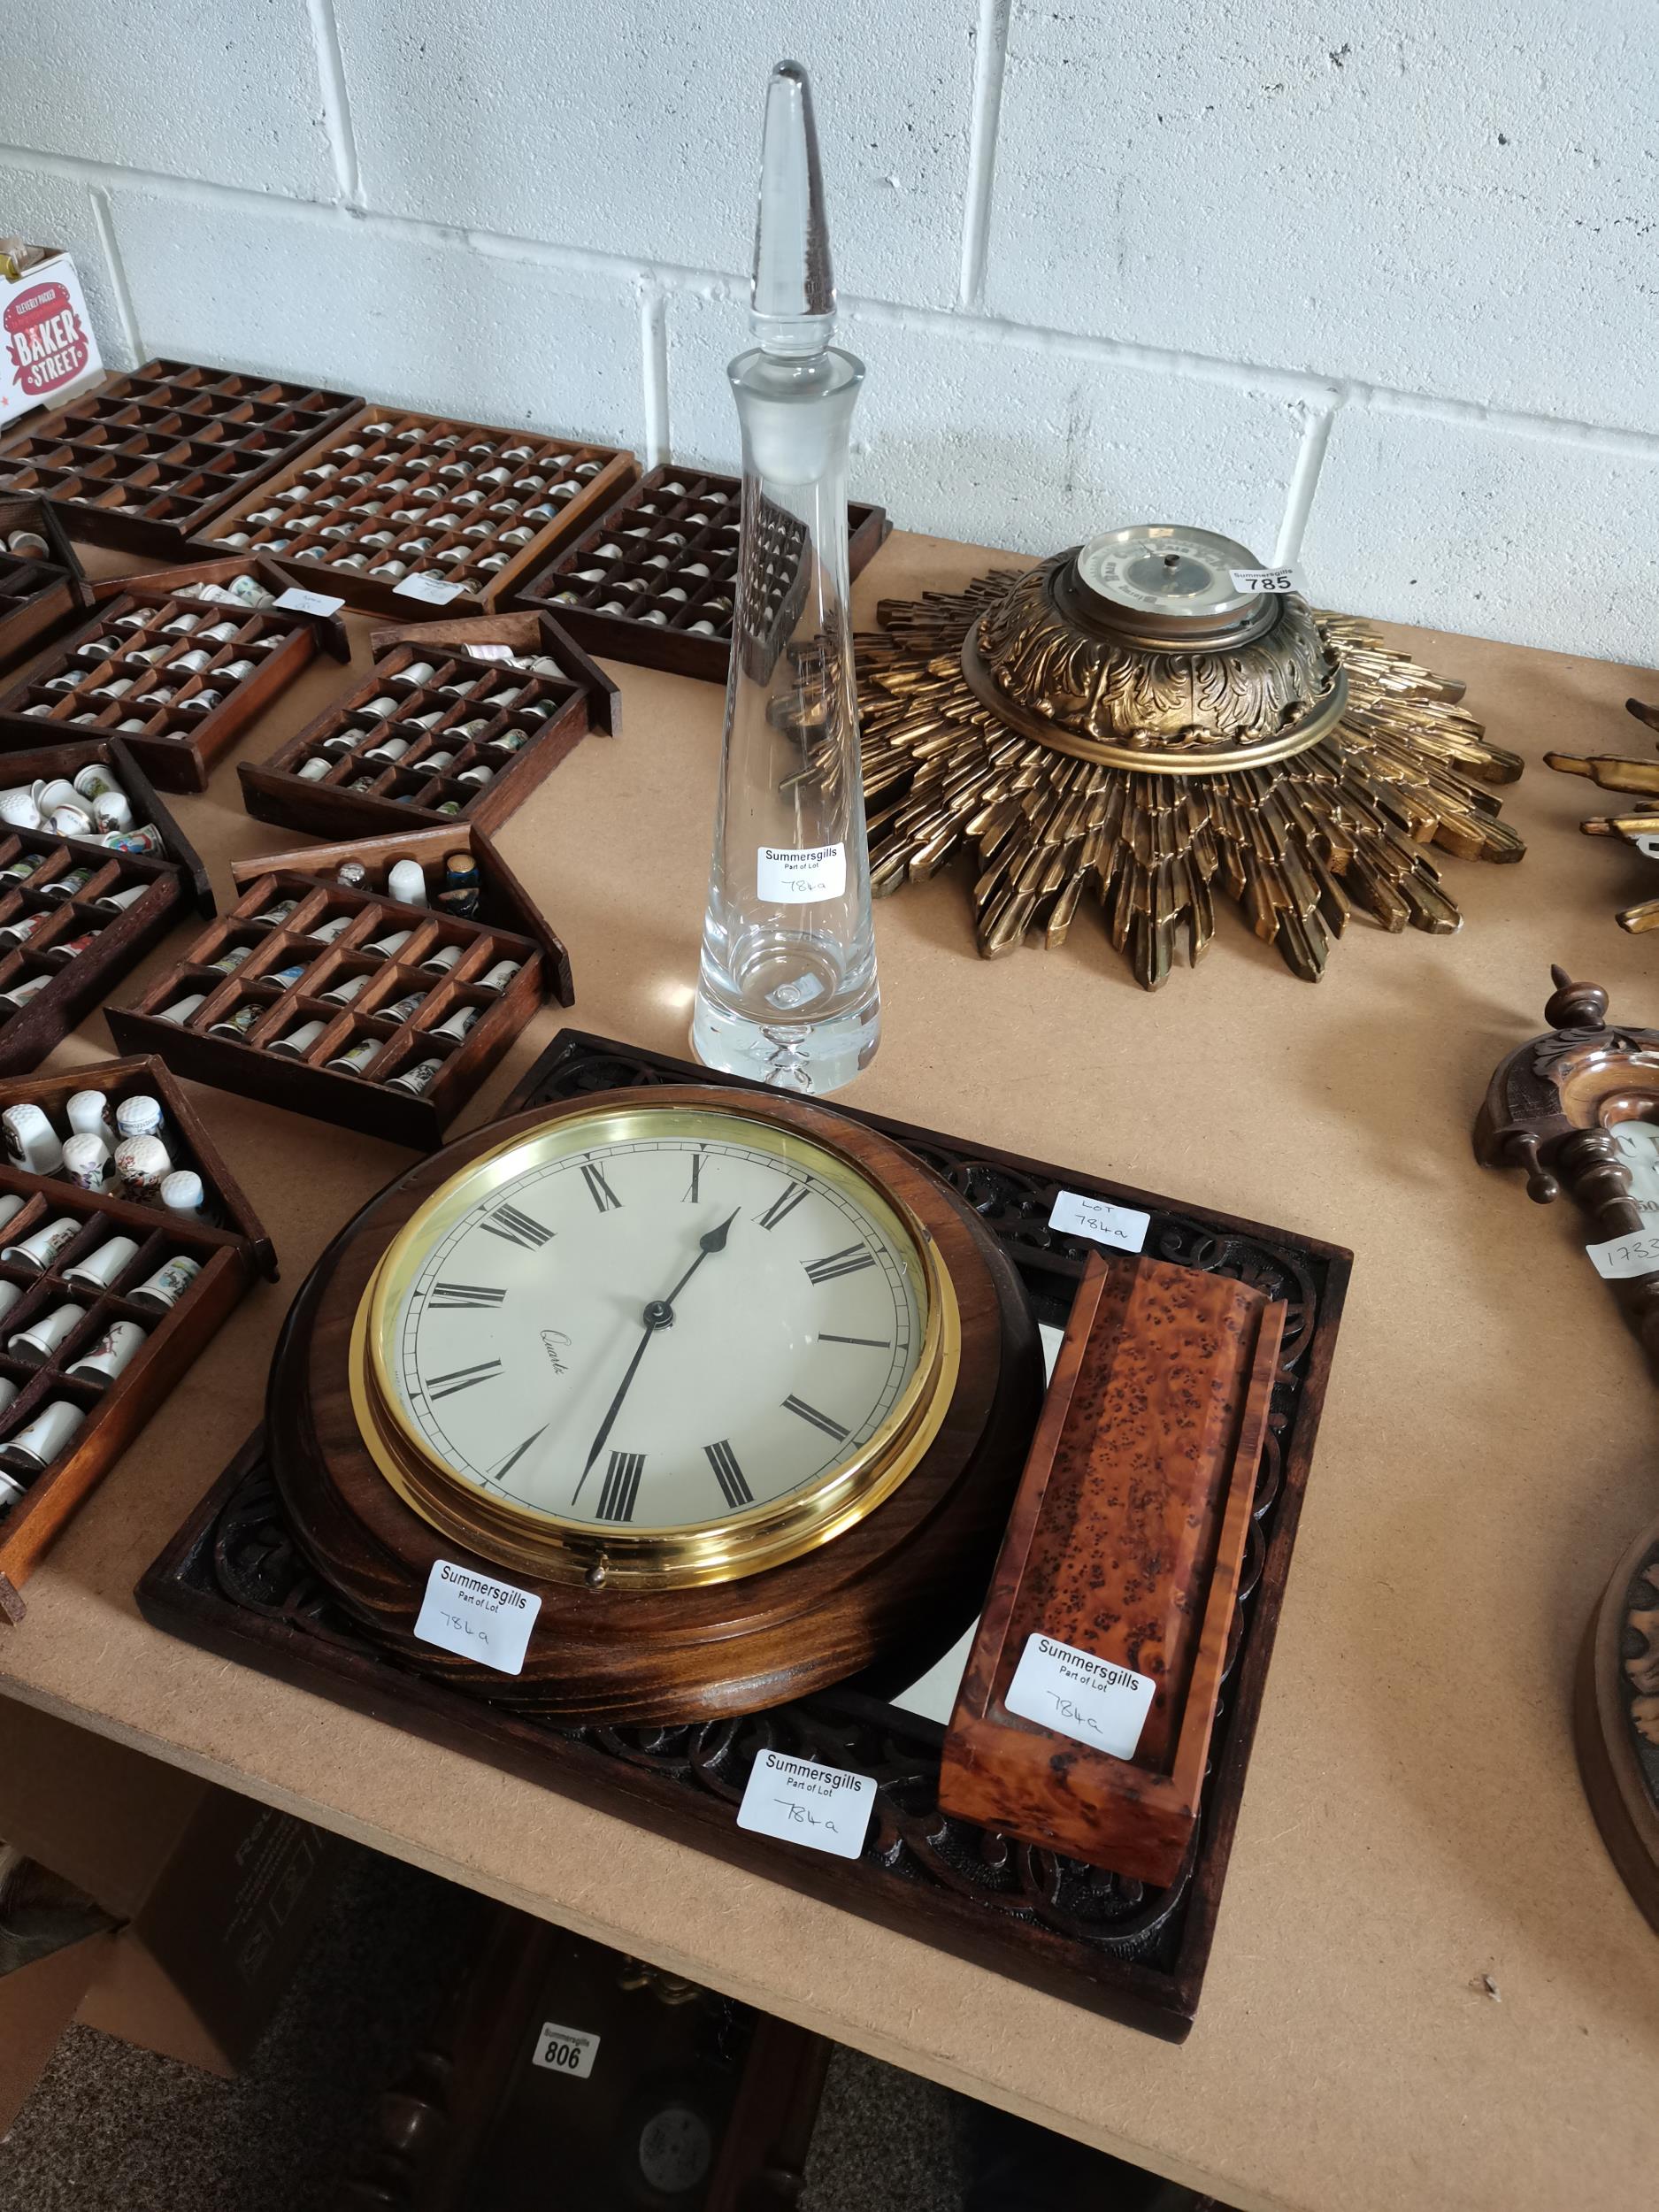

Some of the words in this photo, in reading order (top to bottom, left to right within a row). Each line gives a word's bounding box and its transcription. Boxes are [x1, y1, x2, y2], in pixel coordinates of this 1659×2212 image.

[14, 310, 80, 367] BAKER
[32, 346, 79, 387] STREET
[1245, 576, 1292, 590] 785
[765, 848, 837, 862] Summersgills
[540, 1329, 572, 1375] Quartz
[441, 1565, 527, 1609] Summersgills
[457, 1590, 474, 1604] Part
[475, 1598, 485, 1607] of
[485, 1602, 499, 1614] Lot
[1038, 1639, 1140, 1692] Summersgills
[1059, 1665, 1079, 1680] Part
[1079, 1674, 1091, 1685] of
[1091, 1678, 1108, 1693] Lot
[765, 1754, 863, 1792] Summersgills
[786, 1777, 805, 1790] Part
[806, 1784, 817, 1793] of
[818, 1786, 833, 1797] Lot
[544, 2040, 581, 2070] 806
